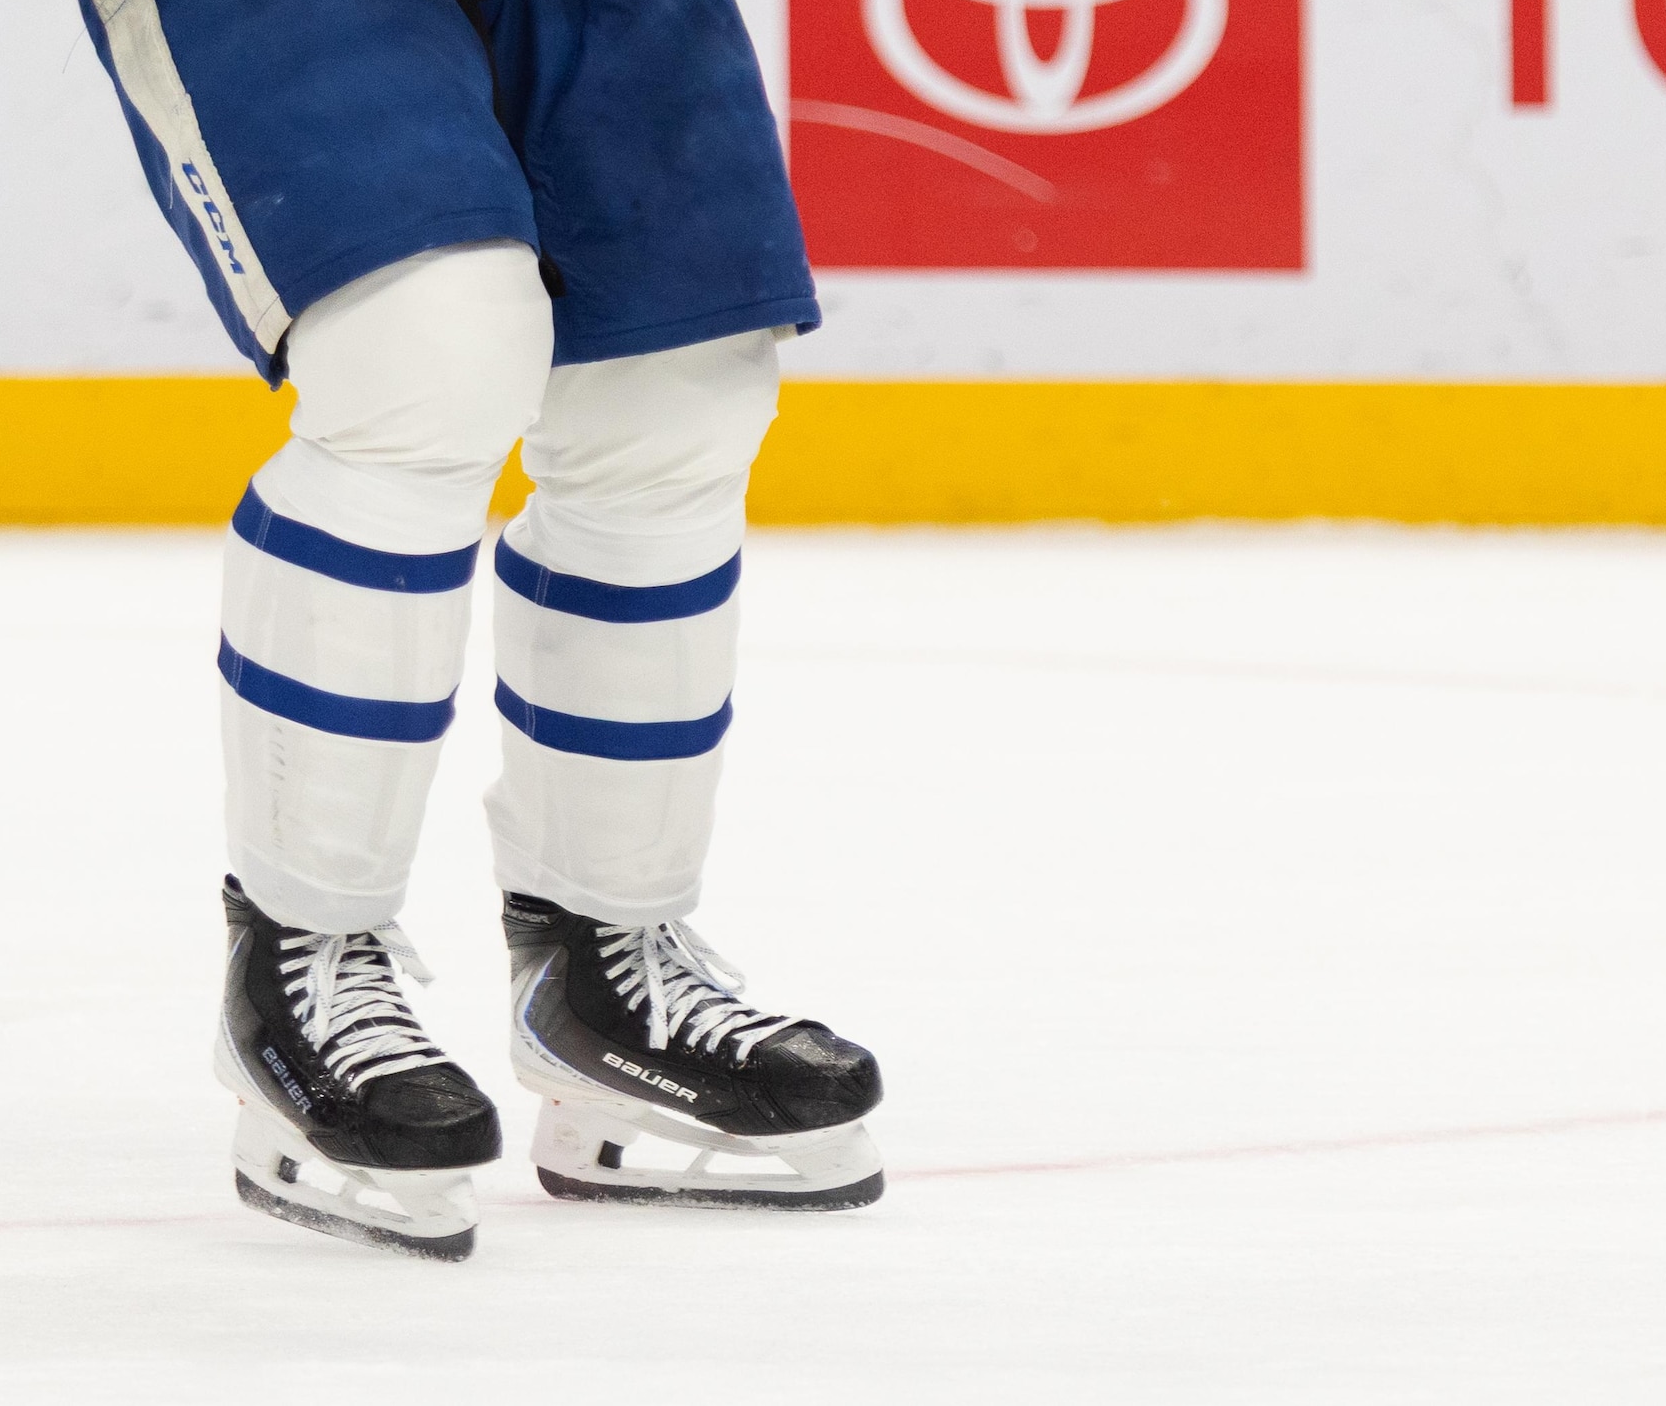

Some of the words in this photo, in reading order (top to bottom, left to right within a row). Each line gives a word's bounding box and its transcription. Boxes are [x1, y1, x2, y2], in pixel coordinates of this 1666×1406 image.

[181, 157, 246, 275] CCM
[261, 1046, 313, 1115] BAUER
[601, 1052, 699, 1104] BAUER
